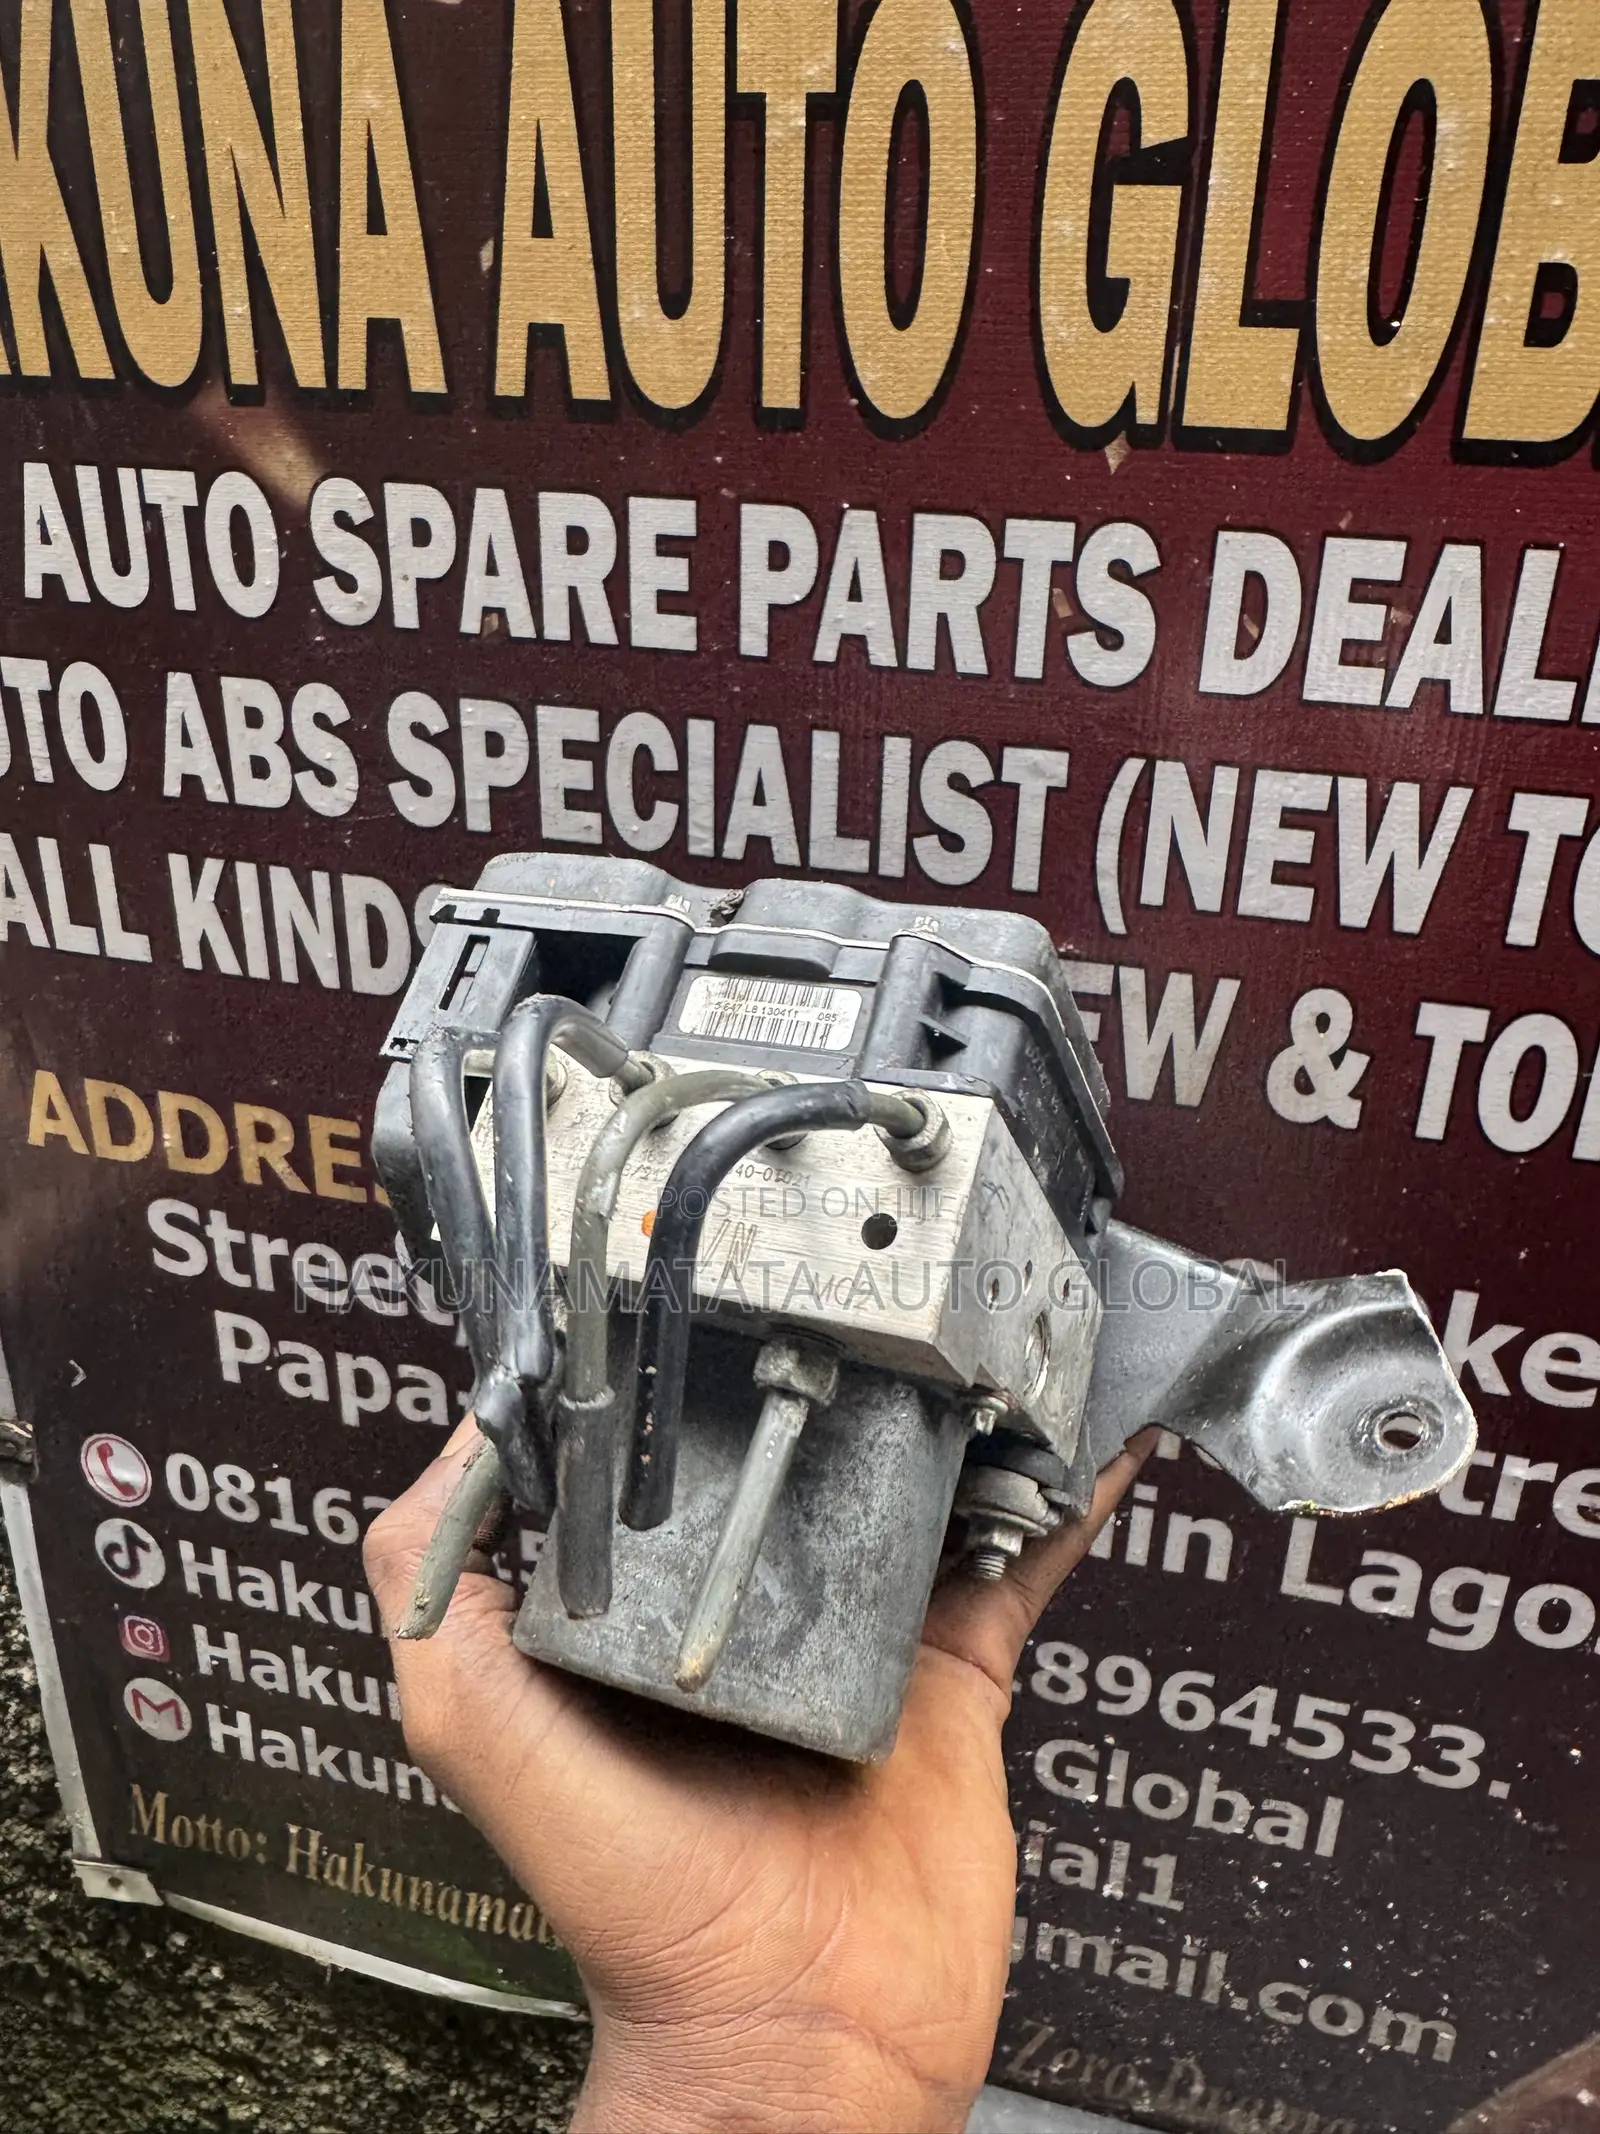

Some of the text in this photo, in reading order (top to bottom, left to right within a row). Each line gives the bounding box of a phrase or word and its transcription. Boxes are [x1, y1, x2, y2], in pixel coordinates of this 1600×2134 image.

[0, 0, 449, 394] KUNA
[494, 0, 977, 419] AUTO
[23, 462, 1600, 724] AUTO SPARE PARTS DEAL
[0, 656, 128, 792] TO
[162, 671, 359, 817] ABS
[387, 692, 1069, 893] SPECIALIST
[1096, 756, 1473, 935] (NEW
[28, 1069, 392, 1208] ADDRE
[1267, 988, 1371, 1130] &
[1414, 1001, 1600, 1163] TO
[166, 1453, 1511, 1797] 0816 8964533.
[1089, 1484, 1234, 1582] in
[1280, 1517, 1600, 1656] Lago
[128, 1783, 269, 1865] Motto:
[206, 1702, 1457, 2063] Hakun mail.com
[1034, 1738, 1343, 1858] Global
